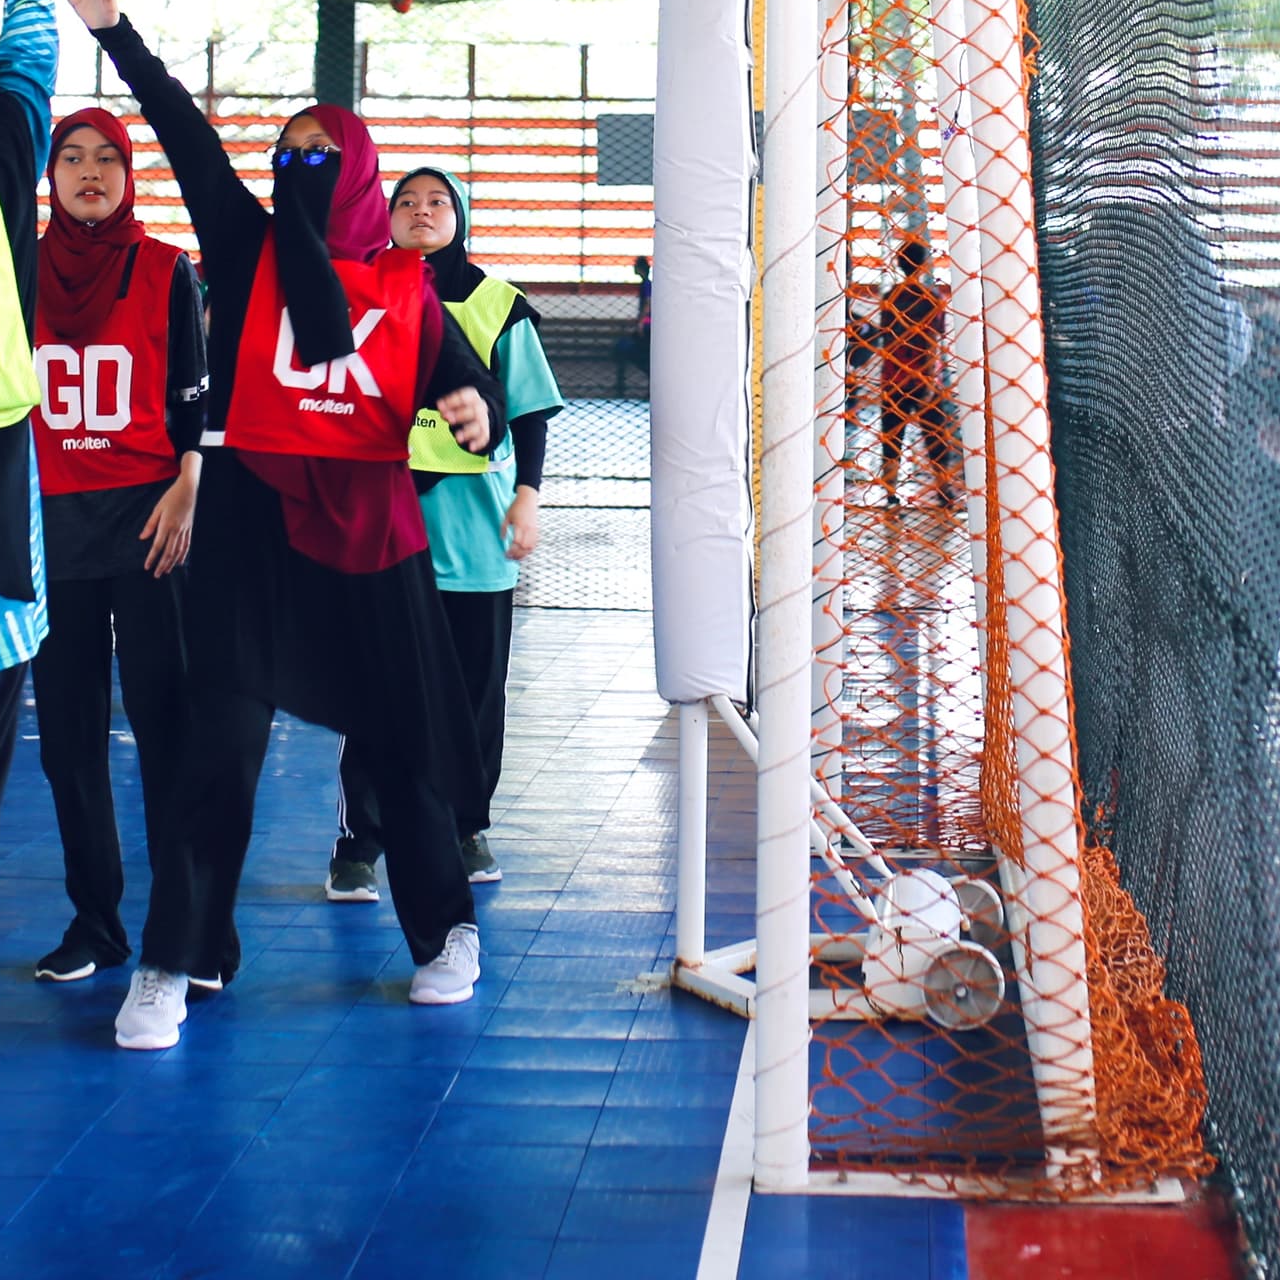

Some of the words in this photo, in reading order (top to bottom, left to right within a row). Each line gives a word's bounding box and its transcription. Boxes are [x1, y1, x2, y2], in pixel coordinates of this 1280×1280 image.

[33, 344, 133, 431] GD
[298, 398, 355, 415] molten
[62, 436, 111, 450] molten
